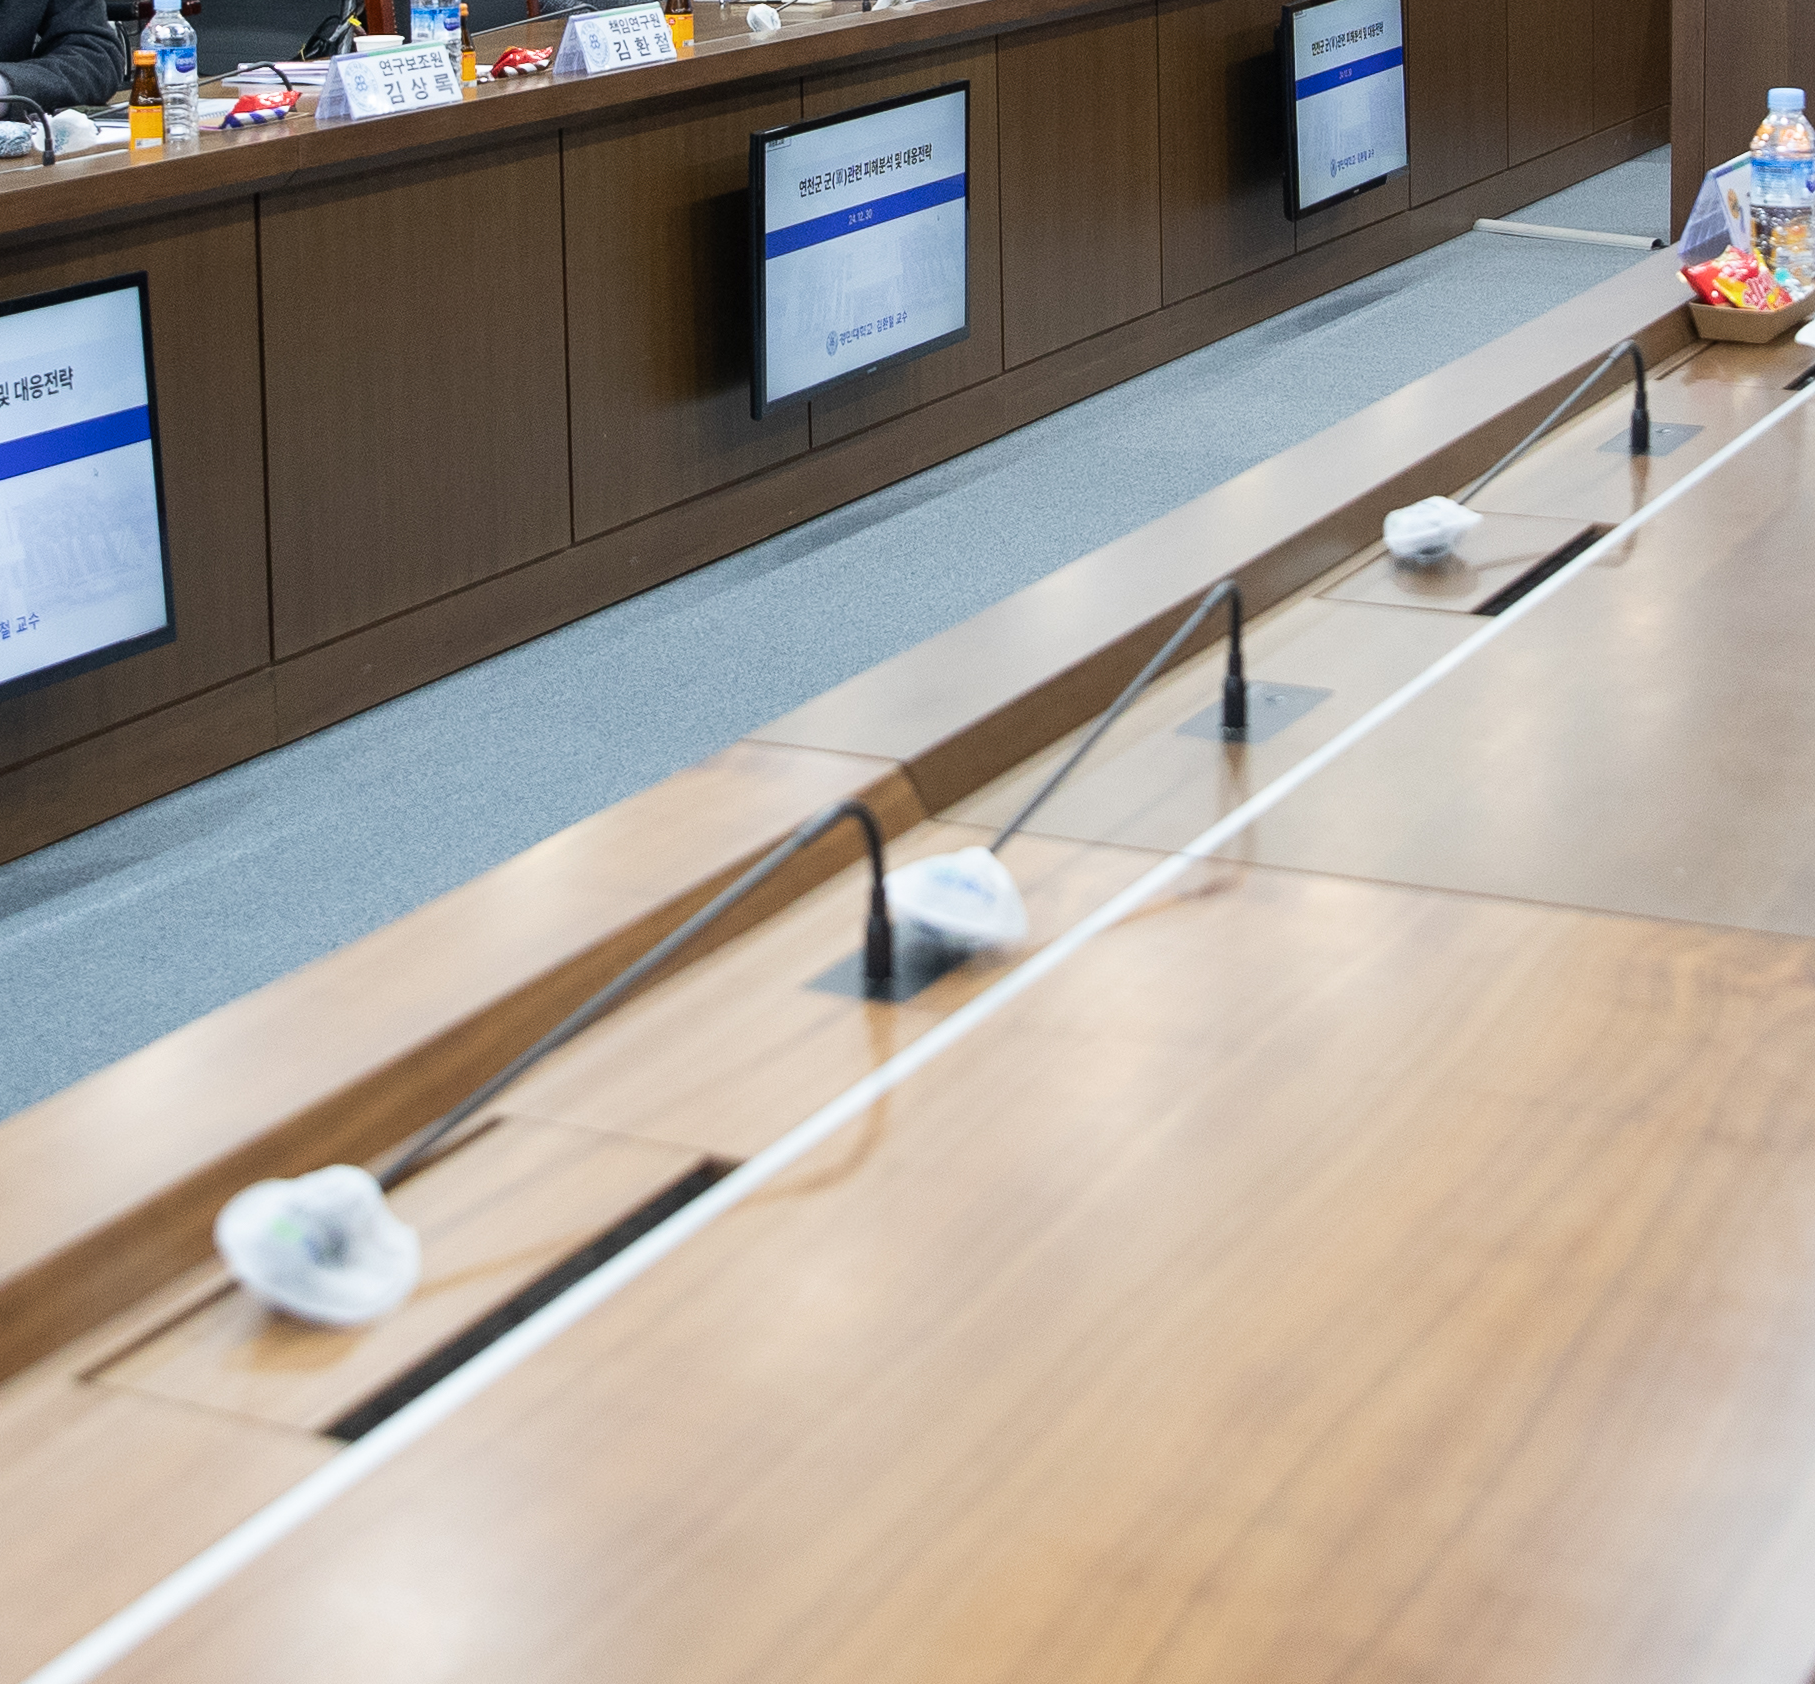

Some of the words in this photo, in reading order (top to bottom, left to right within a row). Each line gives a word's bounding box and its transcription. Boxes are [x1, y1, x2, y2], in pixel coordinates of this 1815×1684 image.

[609, 13, 662, 34] 책임연구원
[613, 32, 671, 61] 김환철
[379, 51, 444, 77] 연구보조원
[385, 73, 454, 105] 김상록
[13, 365, 74, 402] 대응전략
[15, 611, 40, 633] 교수
